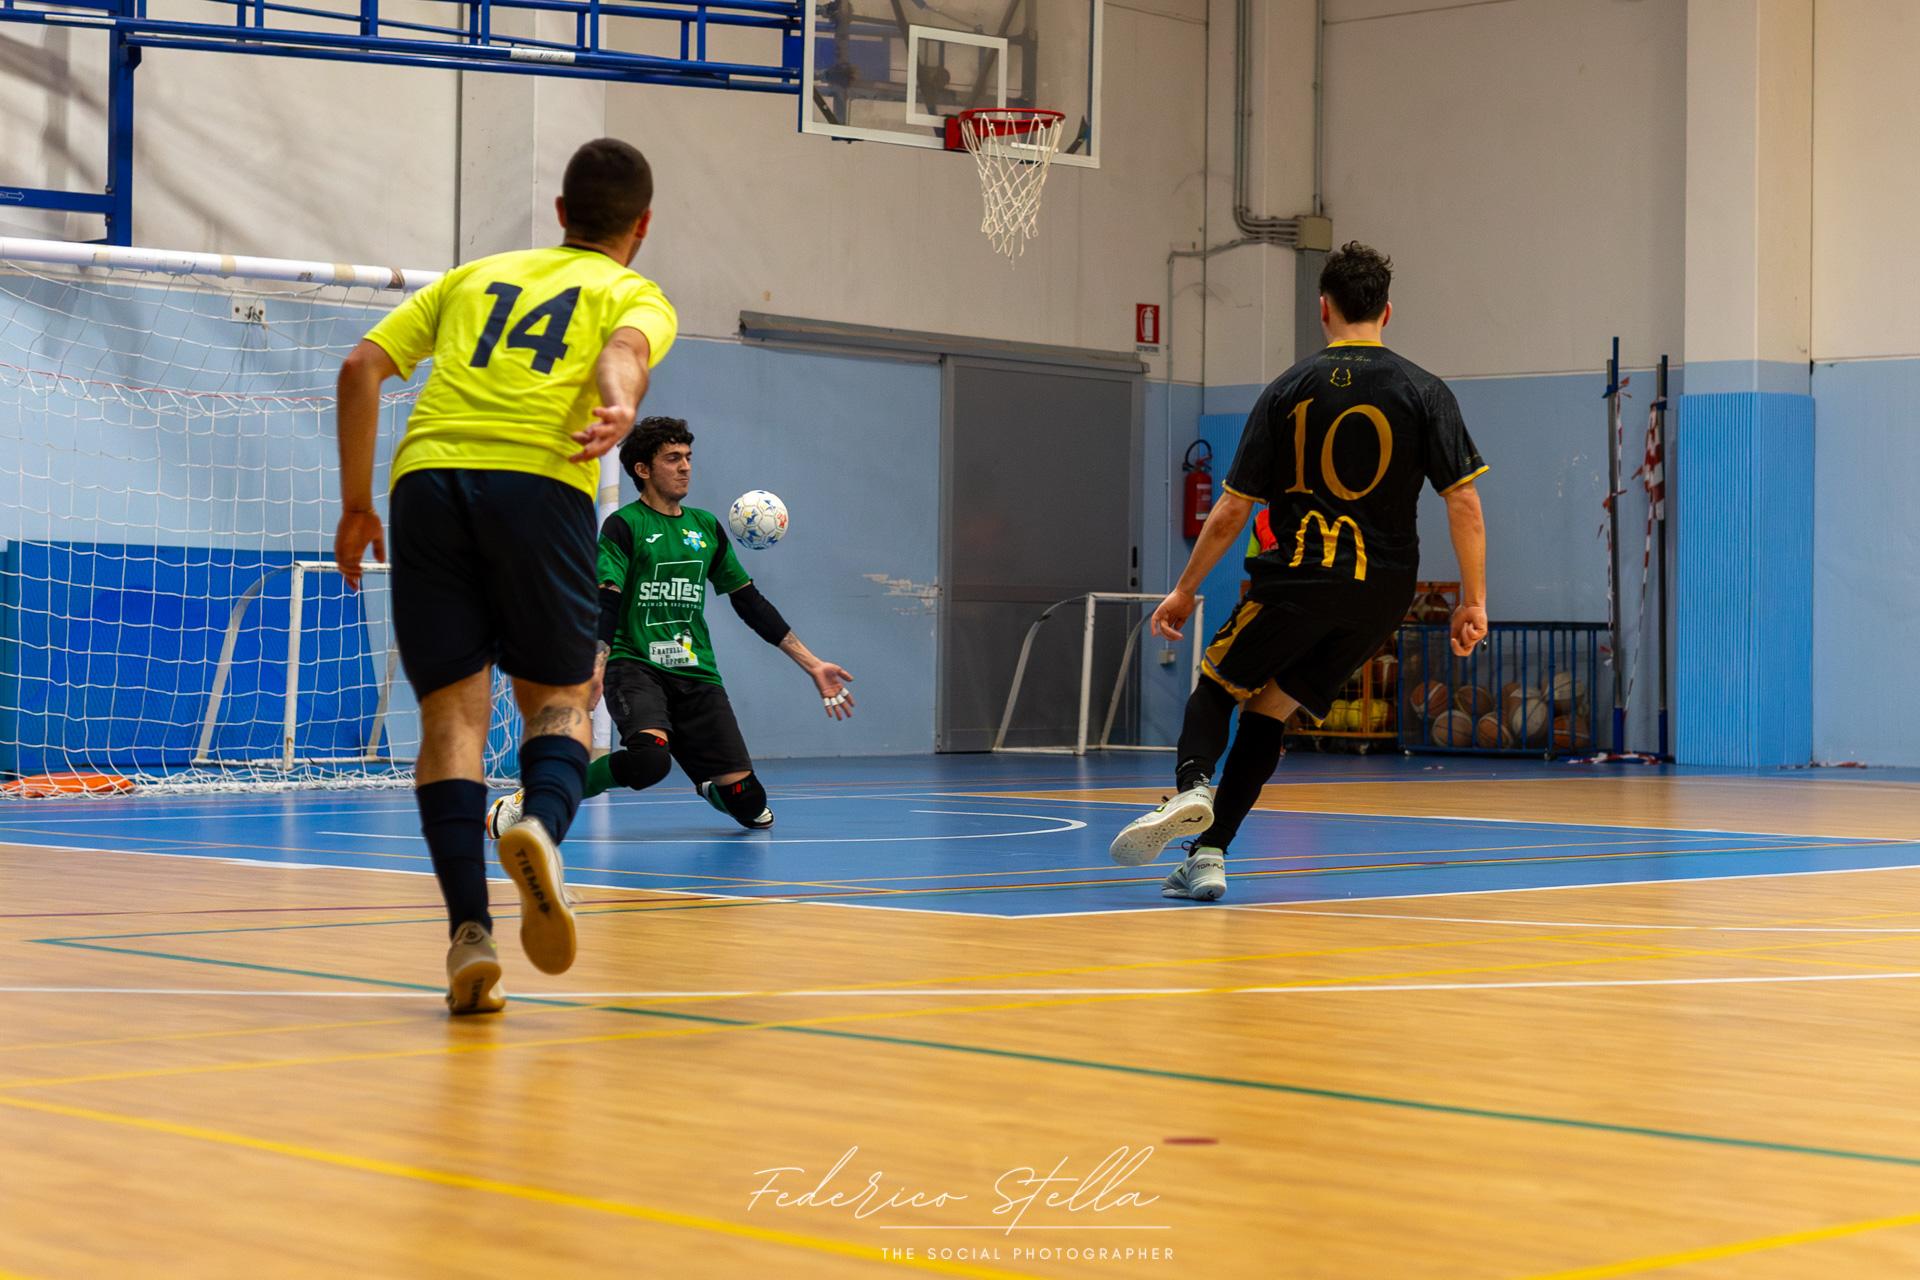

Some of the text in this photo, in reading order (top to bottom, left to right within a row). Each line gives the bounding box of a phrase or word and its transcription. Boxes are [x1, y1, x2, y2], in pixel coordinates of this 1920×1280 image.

[469, 281, 582, 375] 14
[1285, 397, 1393, 501] 10
[515, 848, 551, 915] TIEMPO
